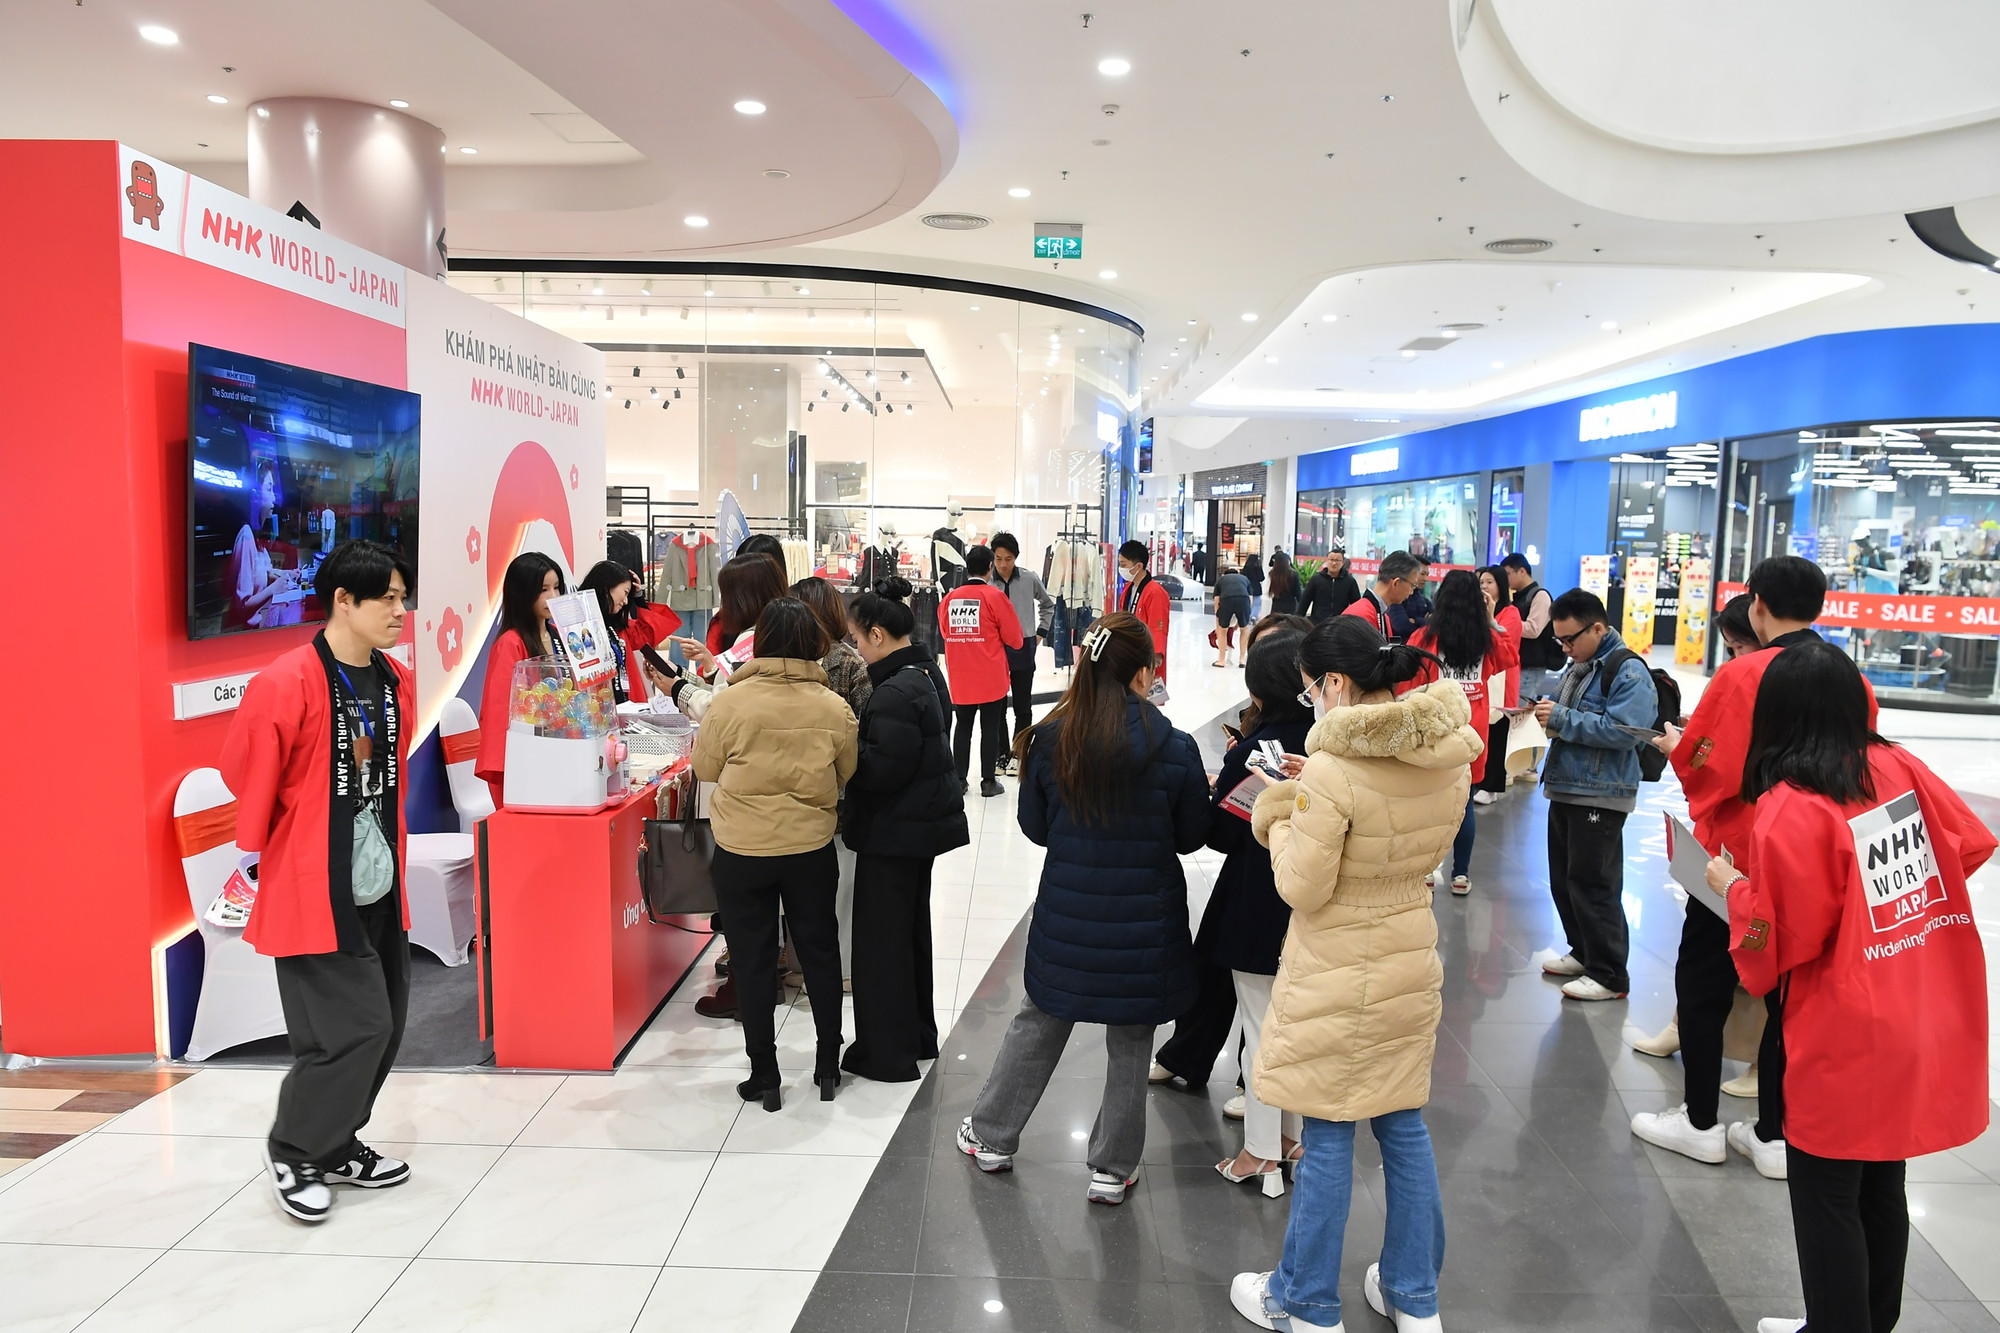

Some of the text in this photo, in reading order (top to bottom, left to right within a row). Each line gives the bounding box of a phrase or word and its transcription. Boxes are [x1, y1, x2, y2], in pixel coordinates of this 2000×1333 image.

[202, 207, 263, 259] NHK
[445, 329, 596, 400] KHÁM PHÁ NHẬT BẢN CÙNG
[211, 387, 221, 398] The
[221, 389, 234, 400] Sound
[240, 392, 256, 403] Vietnam
[471, 377, 503, 409] NHK
[1741, 462, 1748, 474] 1
[1758, 492, 1767, 505] 2
[1776, 522, 1786, 534] 3
[951, 608, 977, 616] NHK
[1820, 601, 1859, 619] SALE
[1881, 603, 1936, 622] SALE
[214, 683, 237, 701] Các
[386, 707, 396, 742] WORLD
[337, 761, 348, 796] JAPAN
[388, 754, 396, 787] JAPAN
[1868, 819, 1925, 870] NHK
[624, 901, 639, 929] Ứng
[1864, 913, 1971, 961] Widening orizons
